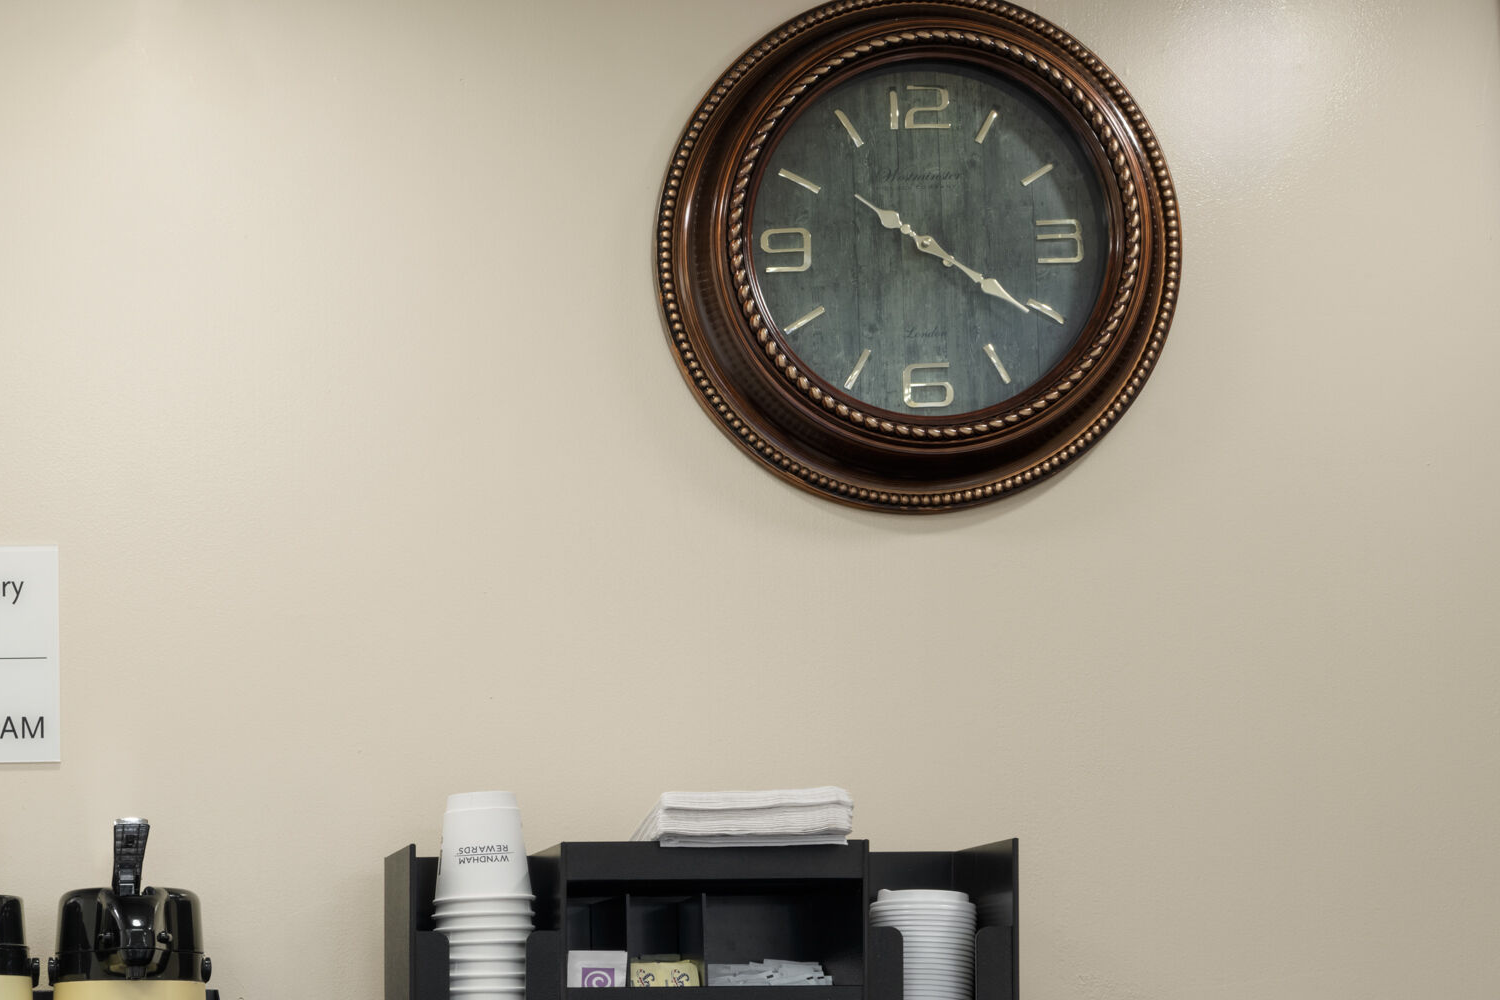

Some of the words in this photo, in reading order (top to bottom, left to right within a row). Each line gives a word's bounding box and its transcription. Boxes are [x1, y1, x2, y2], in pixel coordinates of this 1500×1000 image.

[889, 85, 952, 130] 12
[760, 227, 812, 273] 9
[1035, 218, 1085, 264] 3
[902, 362, 955, 408] 6
[0, 716, 45, 740] AM
[458, 844, 509, 855] REWARDS
[458, 855, 510, 865] WYNDHAM
